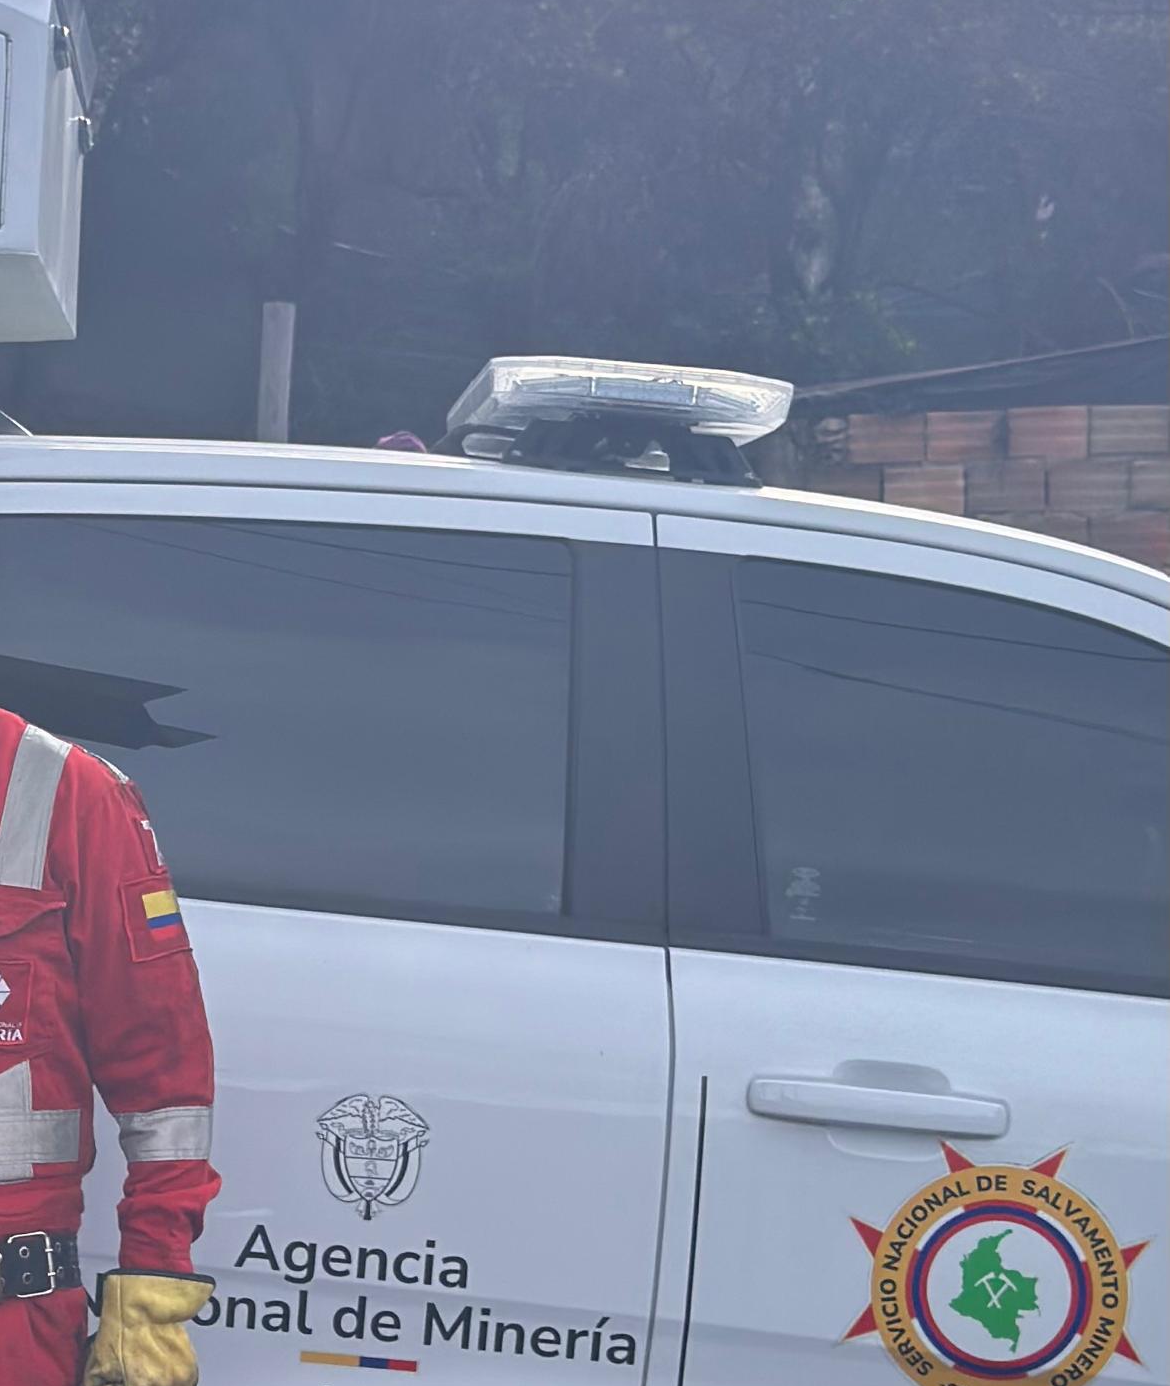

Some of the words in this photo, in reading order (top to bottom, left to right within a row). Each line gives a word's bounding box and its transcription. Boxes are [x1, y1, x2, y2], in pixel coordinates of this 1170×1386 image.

[976, 1175, 1007, 1192] DE
[234, 1224, 470, 1290] Agencia
[882, 1180, 970, 1271] NACIONAL
[1021, 1179, 1119, 1310] SALVAMENTO
[333, 1295, 402, 1344] de
[422, 1301, 638, 1366] Minería
[880, 1279, 934, 1376] SERVICIO
